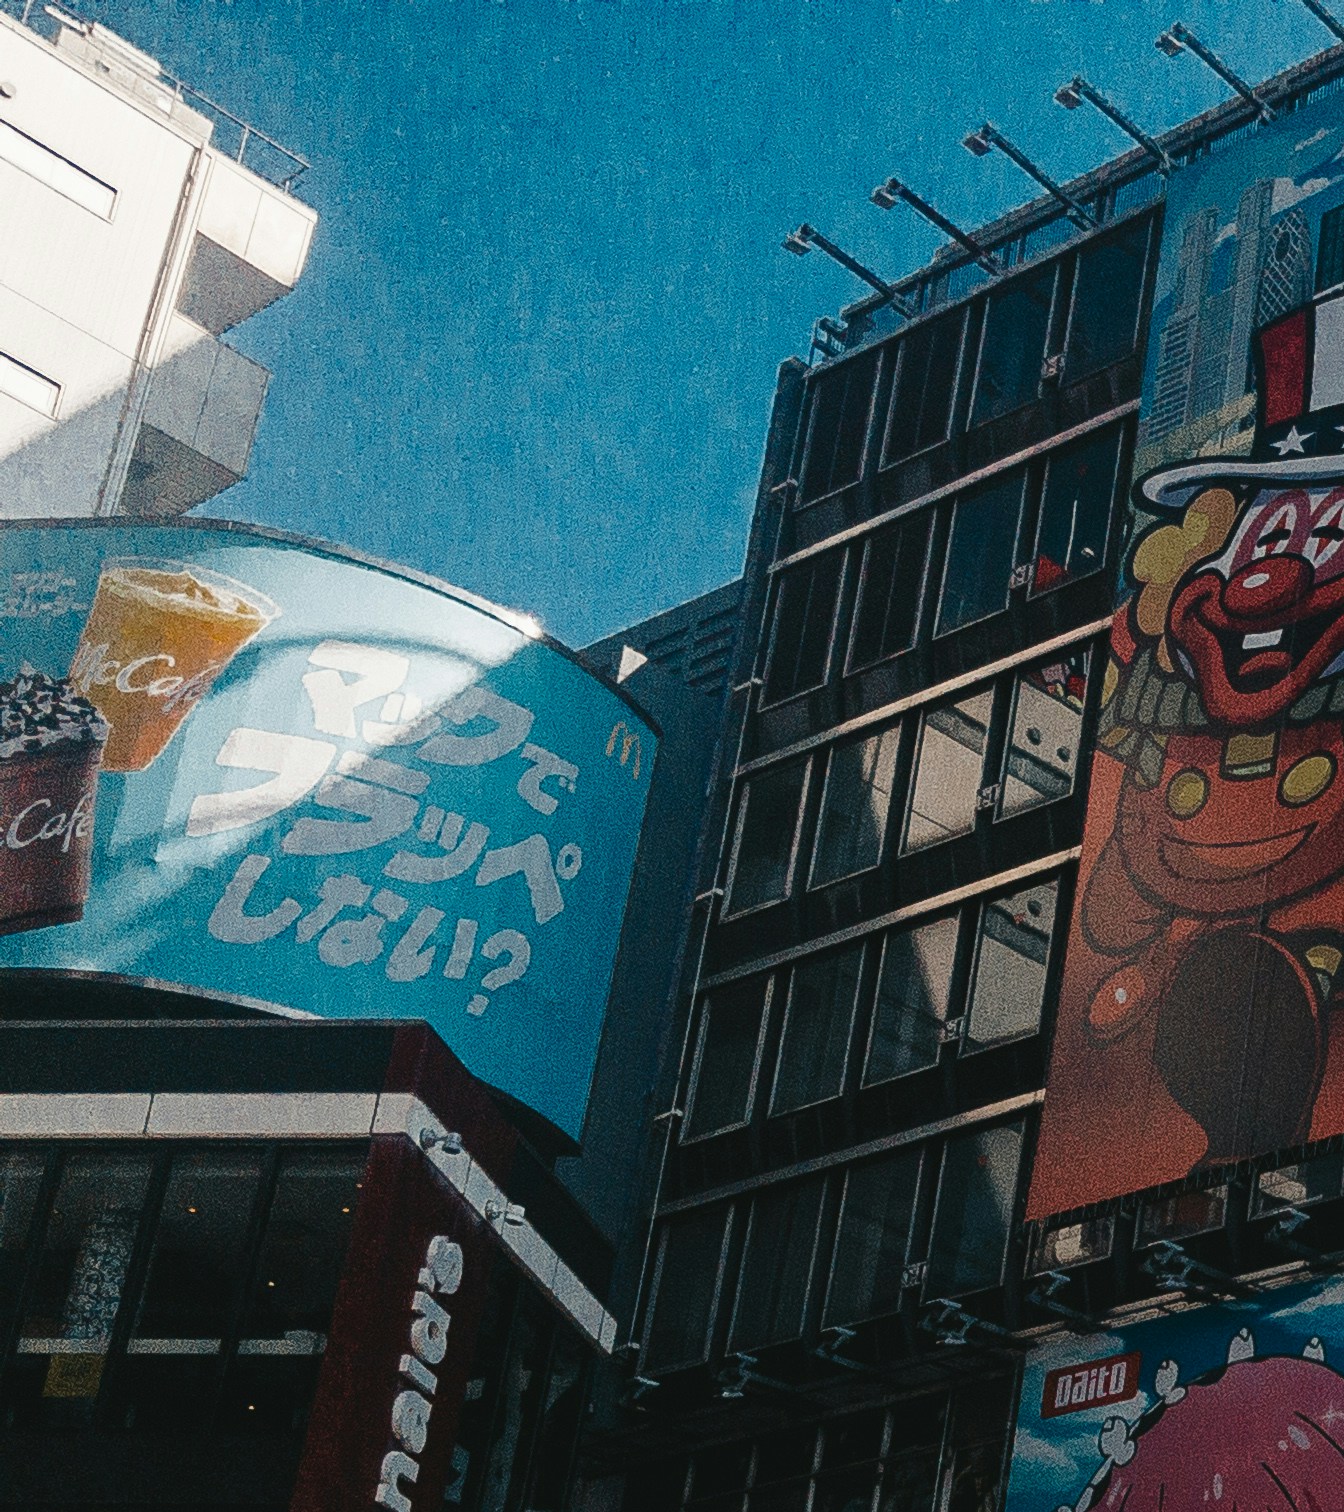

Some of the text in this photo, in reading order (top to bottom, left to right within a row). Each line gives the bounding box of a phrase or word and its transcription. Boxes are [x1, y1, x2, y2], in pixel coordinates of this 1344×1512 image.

[302, 640, 579, 817] マックで
[187, 727, 582, 925] フラッペ
